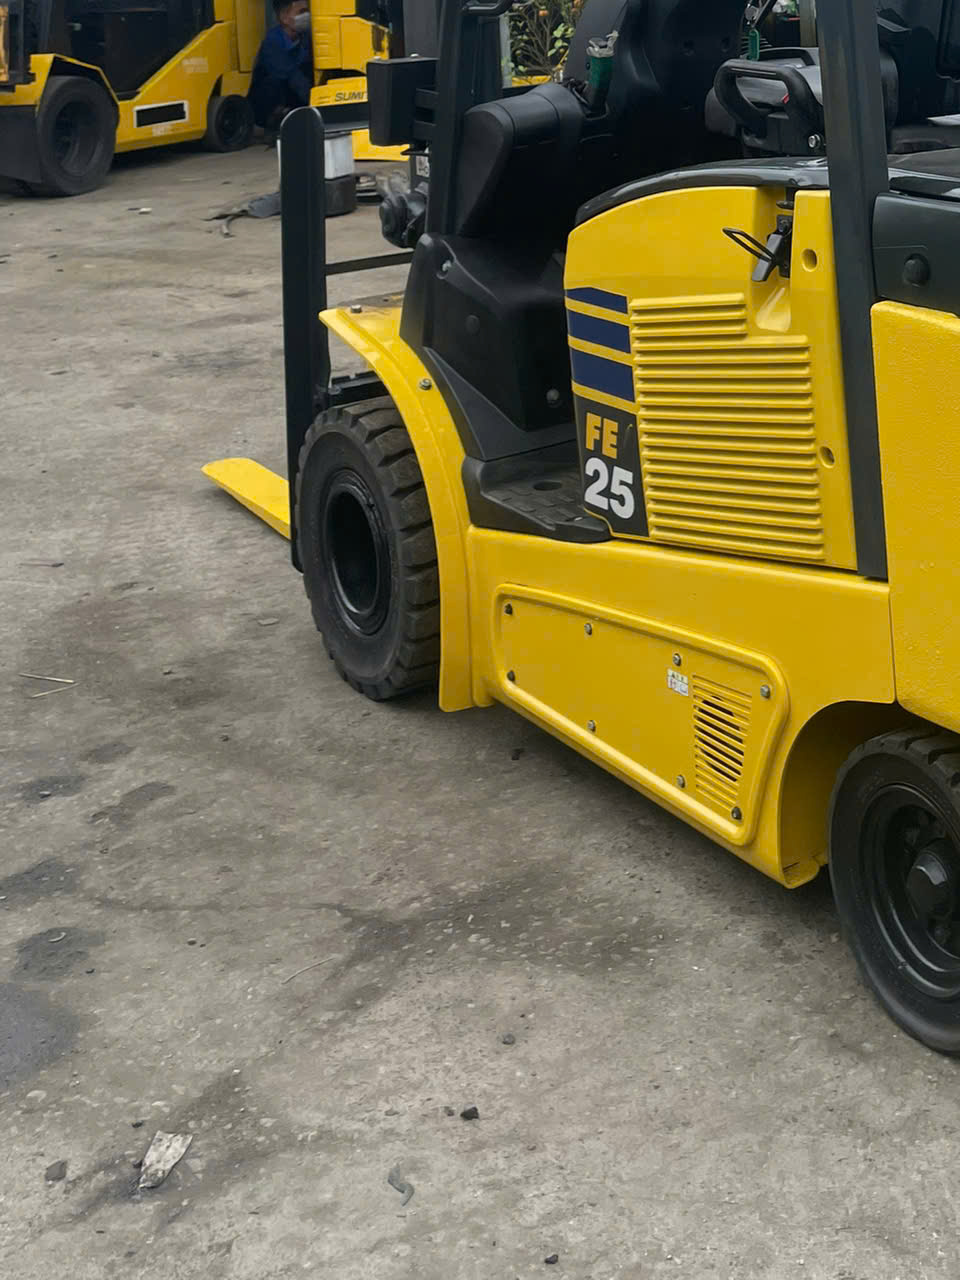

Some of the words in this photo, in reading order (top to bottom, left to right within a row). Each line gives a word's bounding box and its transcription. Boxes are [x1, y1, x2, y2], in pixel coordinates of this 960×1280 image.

[334, 90, 367, 102] SUMI
[585, 411, 619, 460] FE
[584, 456, 635, 519] 25
